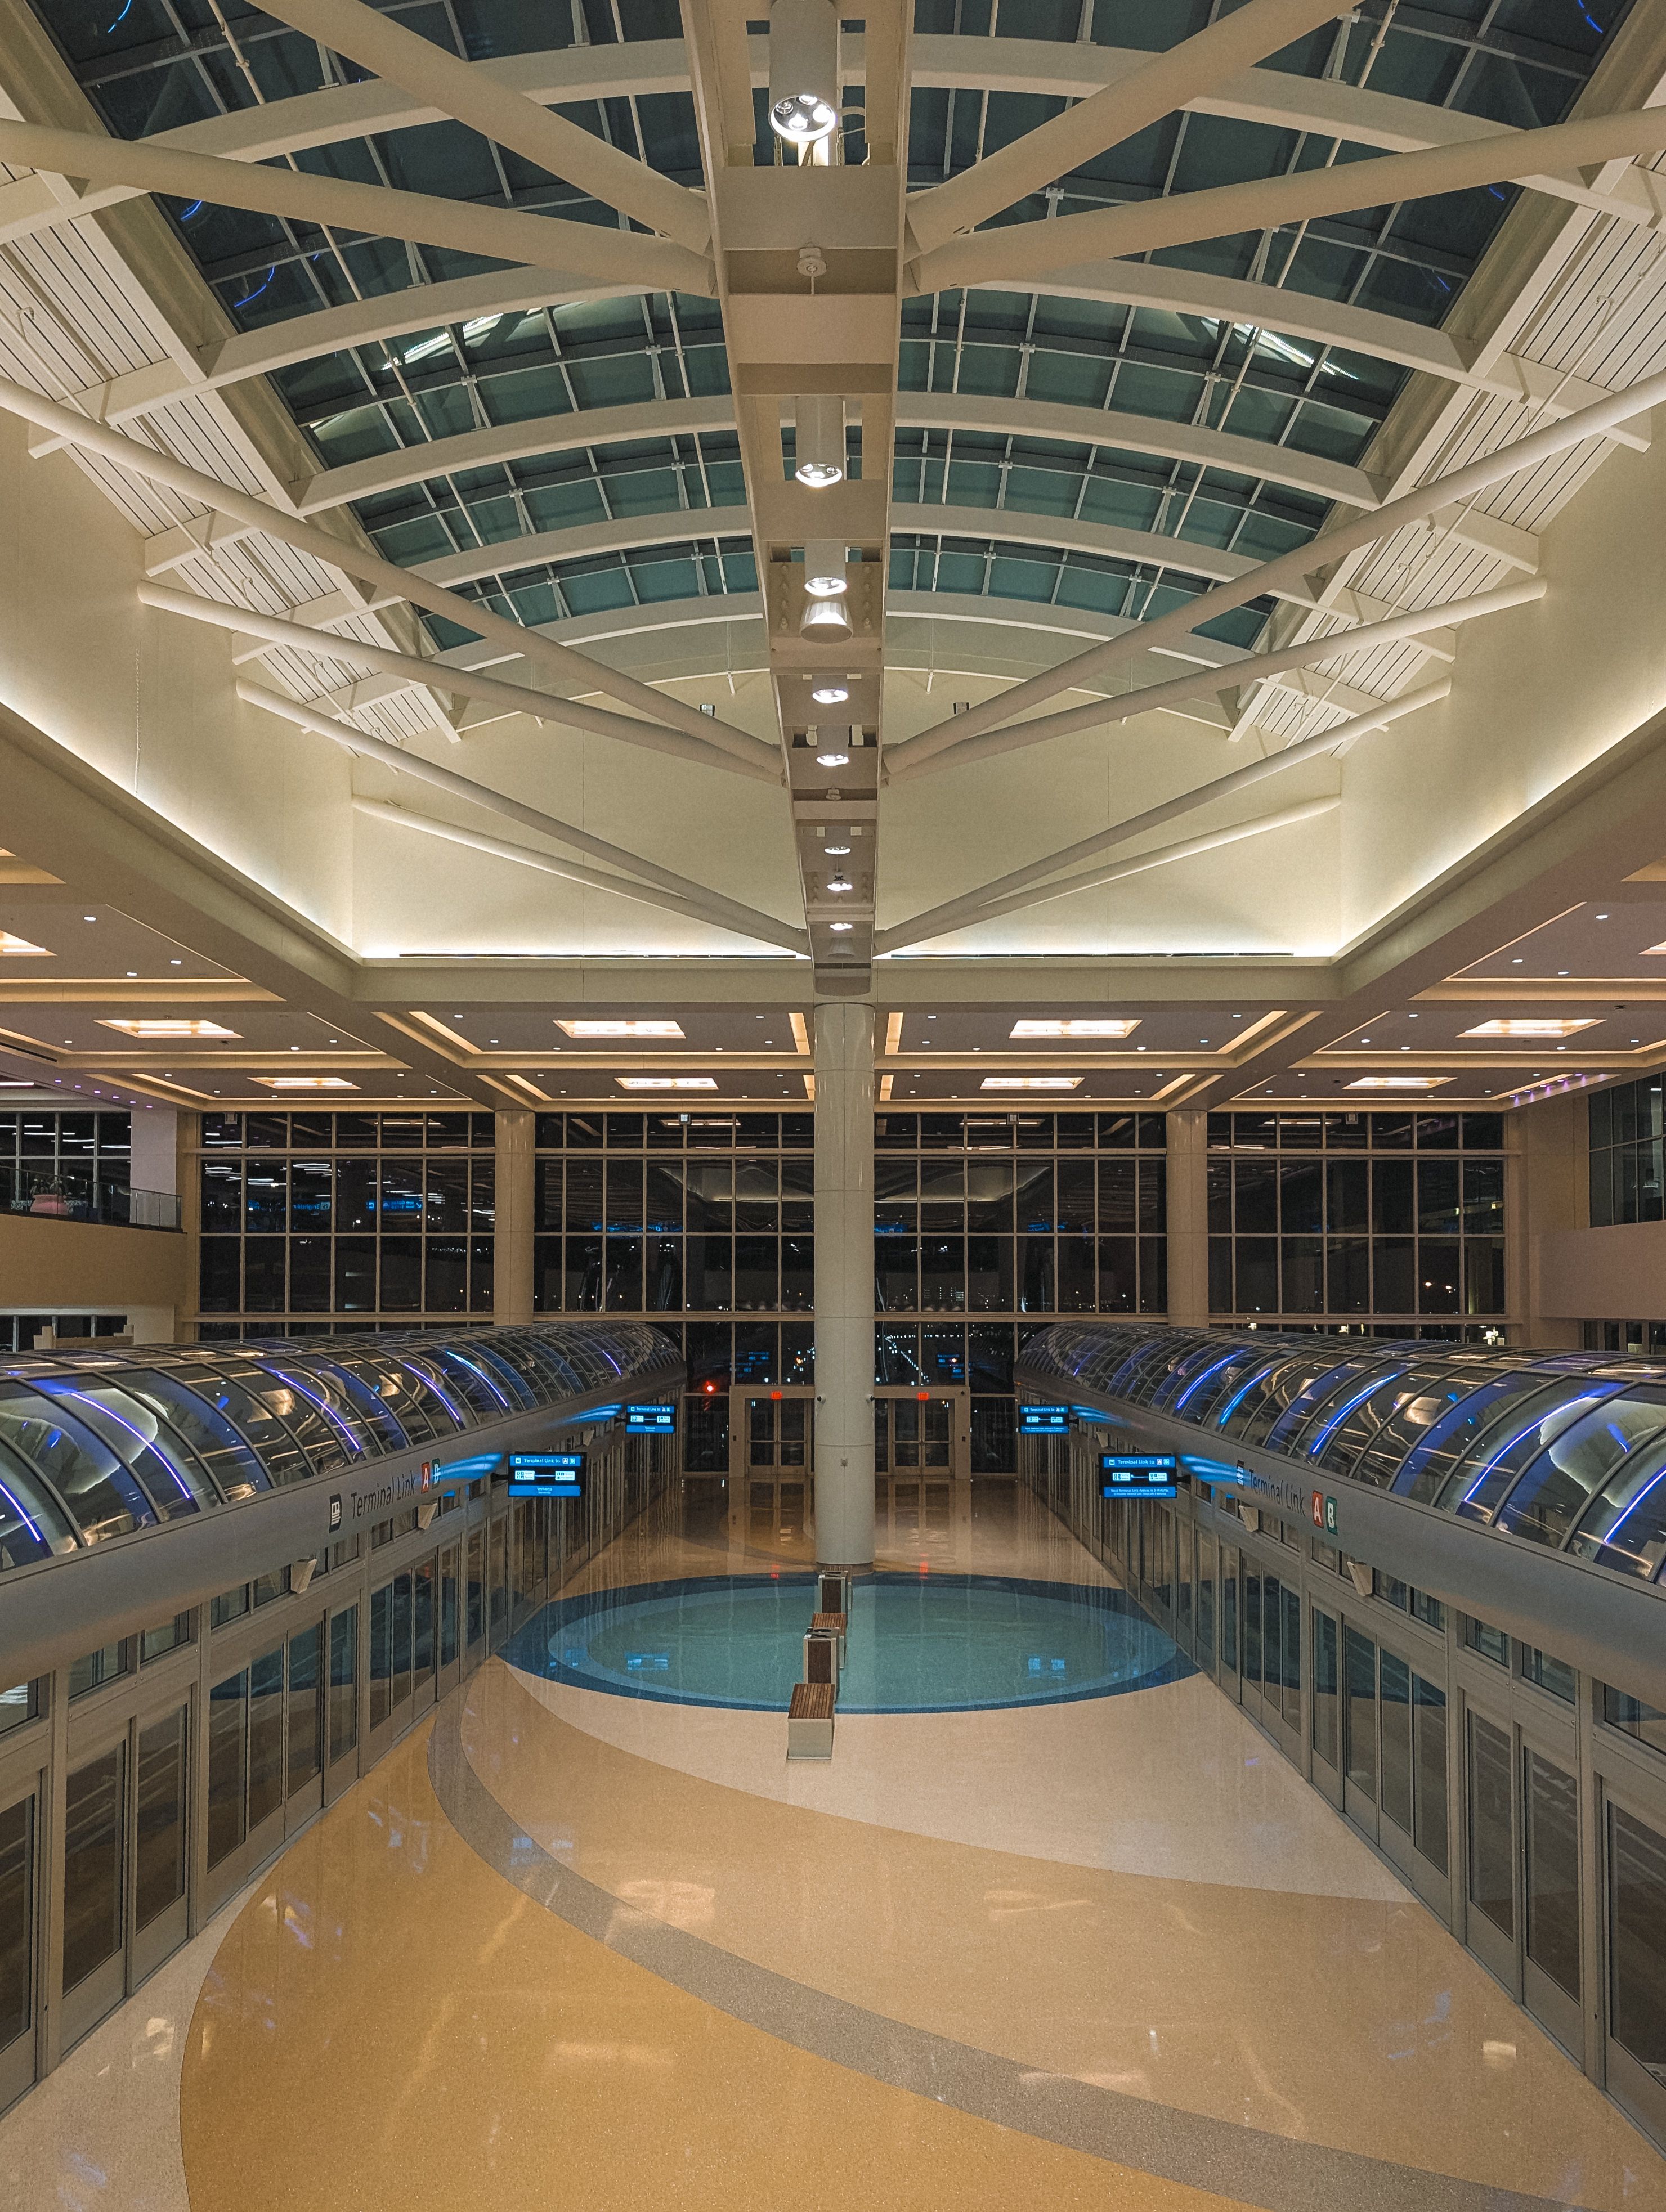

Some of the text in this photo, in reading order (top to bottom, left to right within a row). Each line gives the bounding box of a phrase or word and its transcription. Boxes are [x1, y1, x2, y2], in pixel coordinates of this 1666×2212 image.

[351, 1464, 441, 1519] Terminal Link A B
[1249, 1469, 1334, 1528] Terminal Link A B
